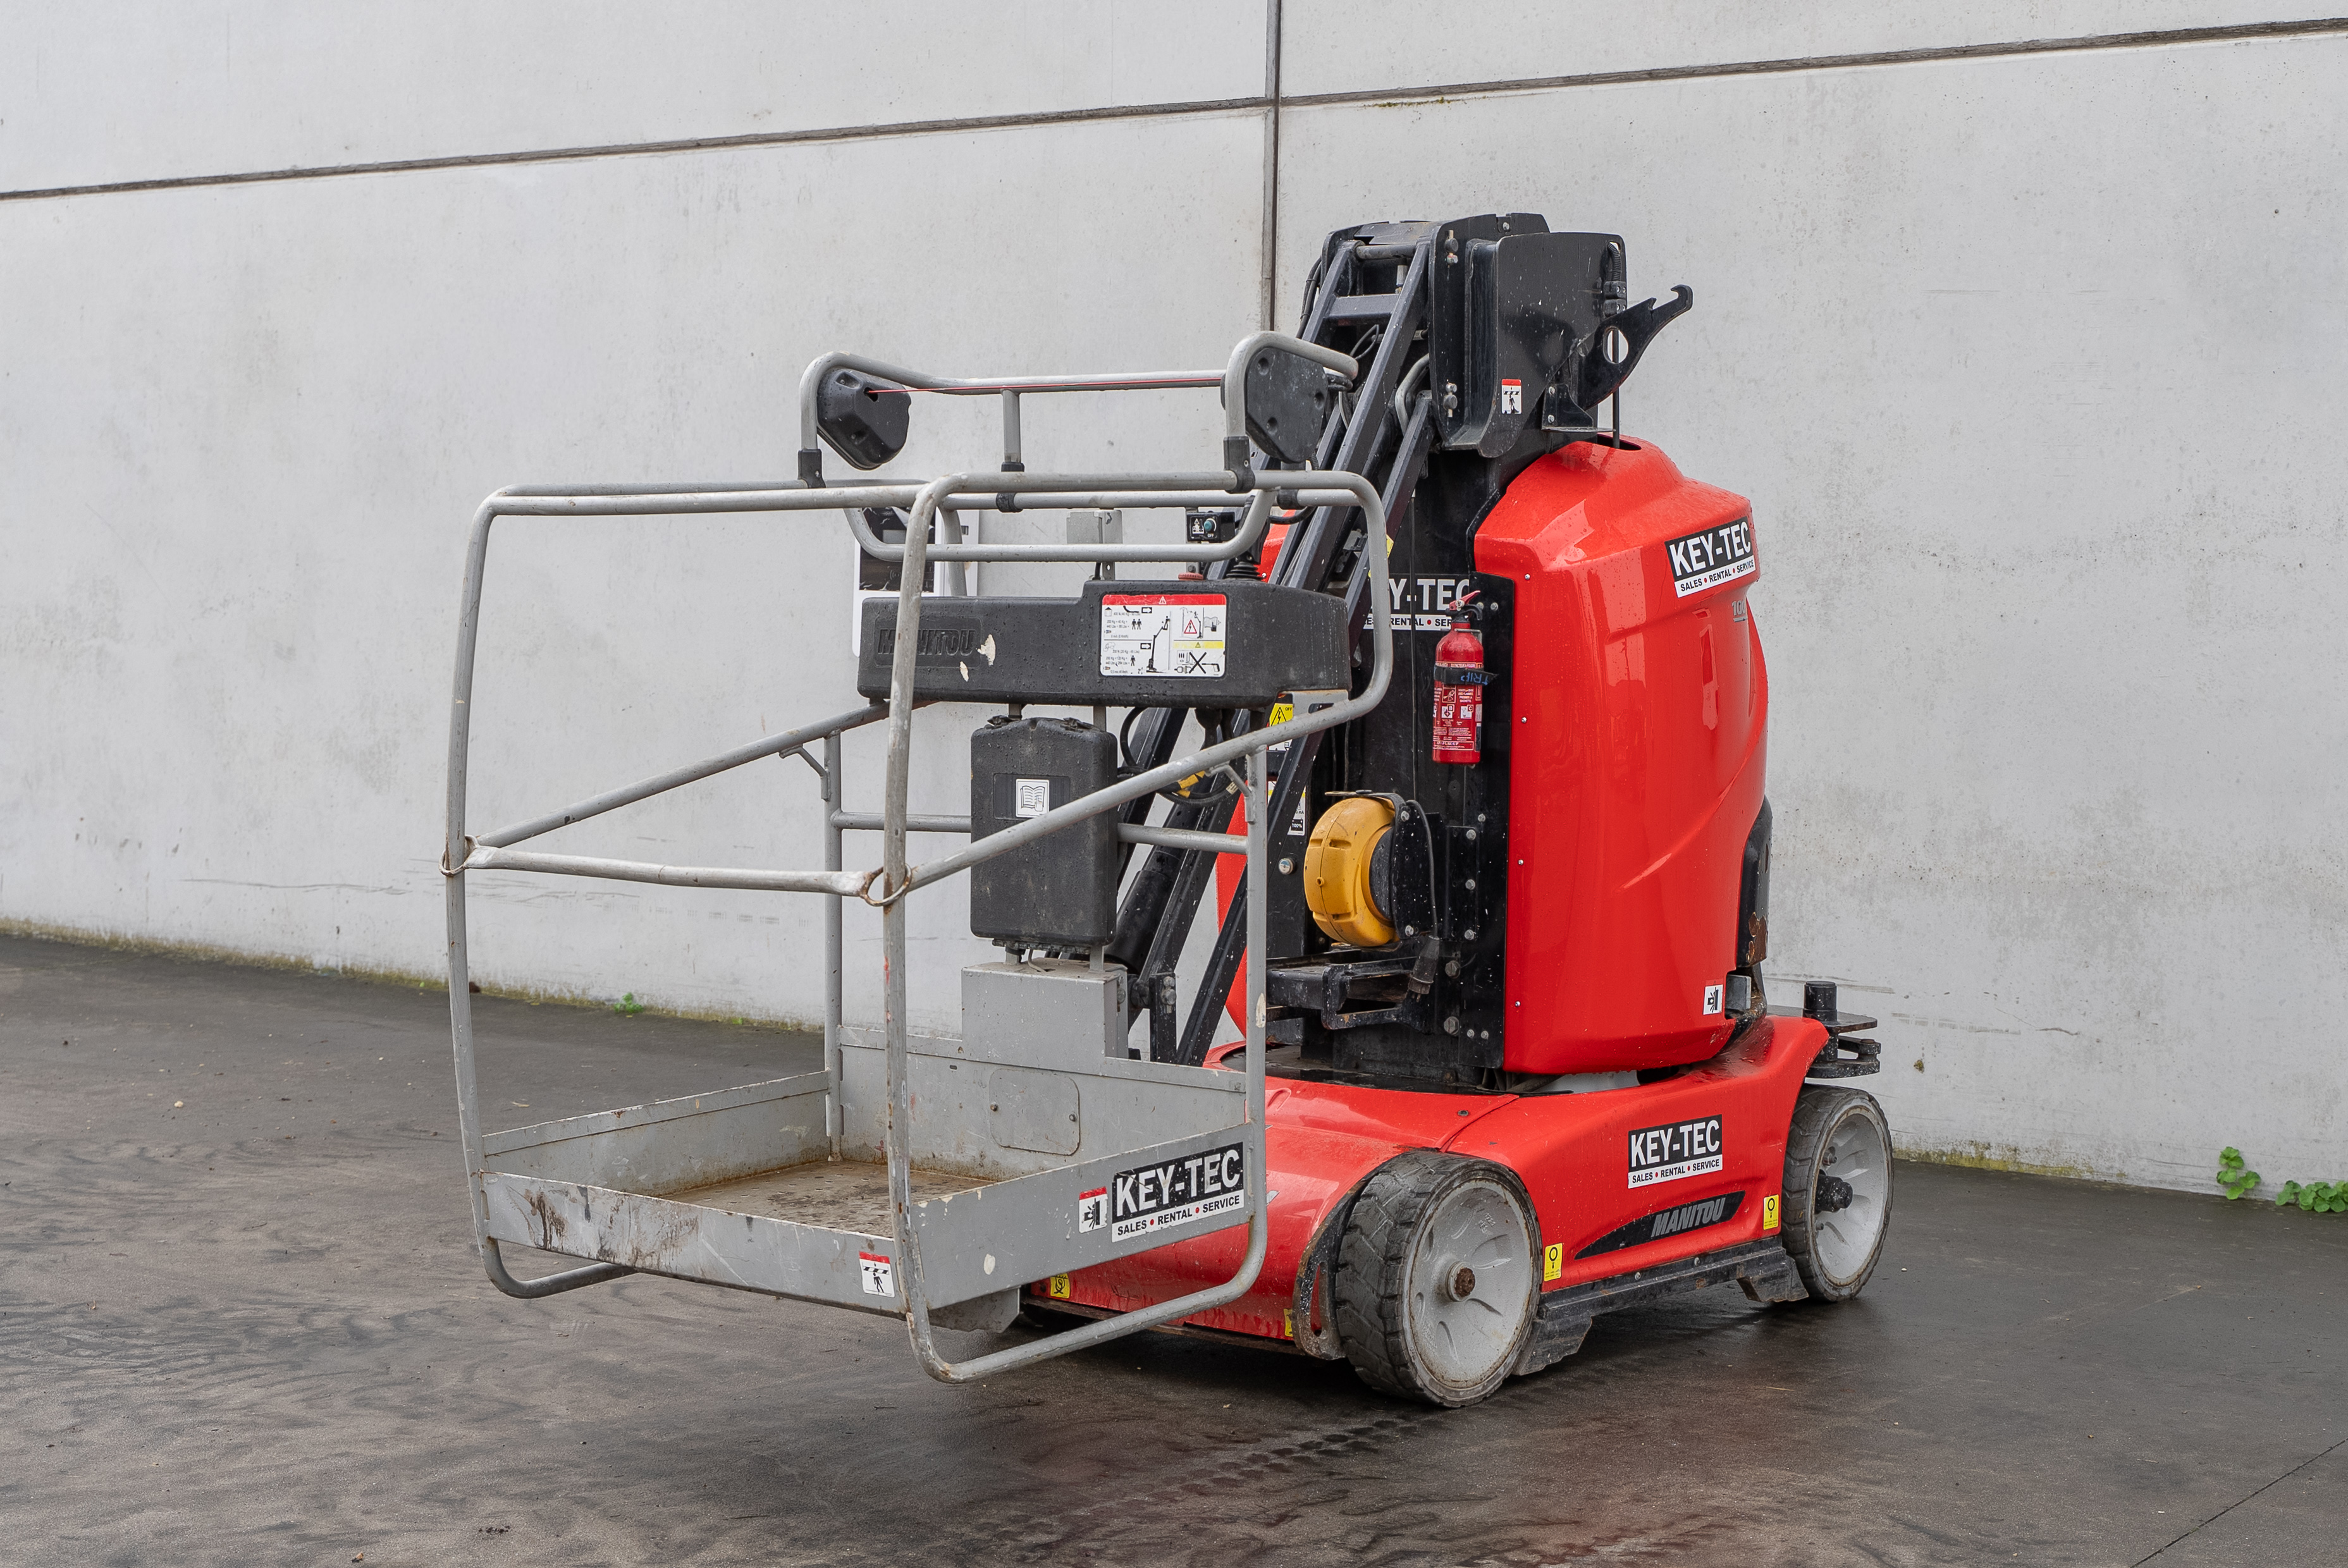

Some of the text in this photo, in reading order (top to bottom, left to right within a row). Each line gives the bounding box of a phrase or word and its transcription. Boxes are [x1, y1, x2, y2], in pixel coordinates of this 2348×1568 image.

[1669, 522, 1751, 577] KEY-TEC
[1680, 559, 1754, 592] SALES RENTAL SERVICE
[878, 628, 976, 656] MNITOU
[1631, 1120, 1720, 1167] KEY-TEC
[1116, 1149, 1240, 1217] KEY-TEC
[1632, 1159, 1719, 1184] SALES RENTAL SERVICE
[1117, 1195, 1240, 1236] SALES RENTAL SERVICE
[1651, 1197, 1726, 1238] MANITOU
